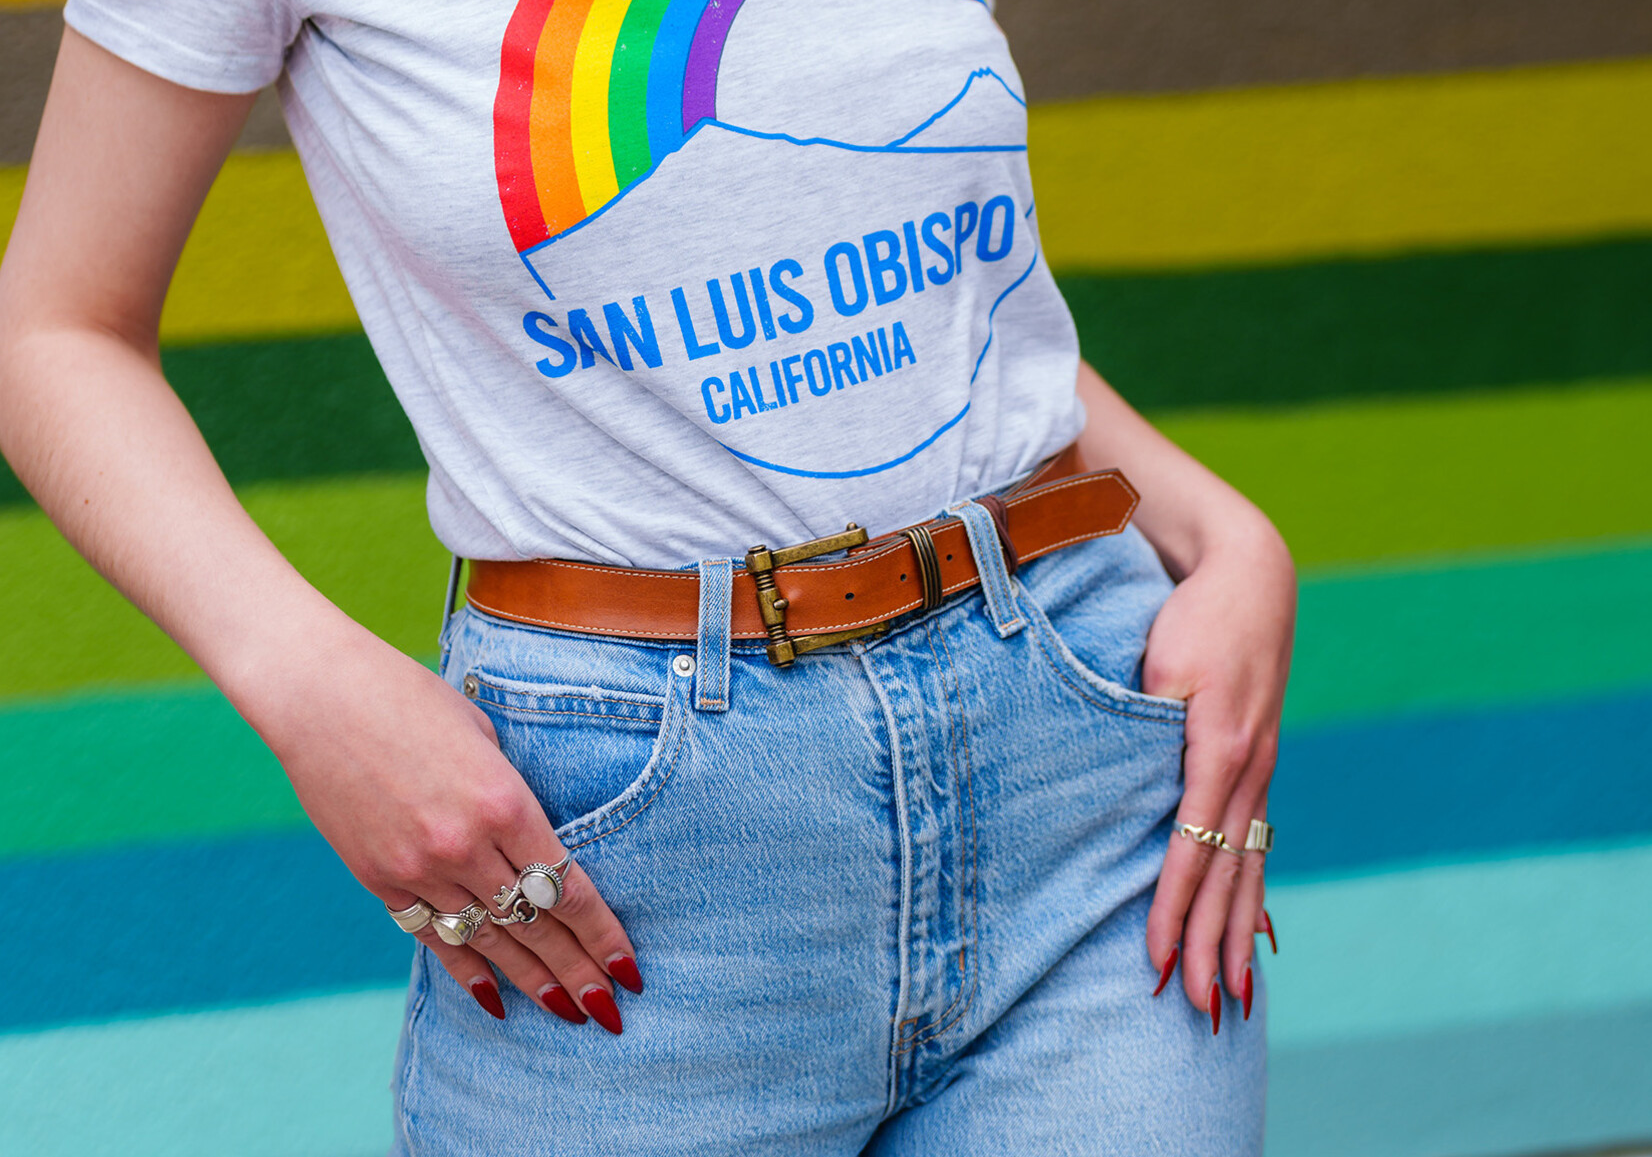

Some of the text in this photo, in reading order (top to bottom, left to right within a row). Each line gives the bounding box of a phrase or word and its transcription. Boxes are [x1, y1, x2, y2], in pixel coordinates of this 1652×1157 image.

[522, 194, 1016, 378] SAN LUIS OBISPO
[700, 320, 917, 425] CALIFORNIA
